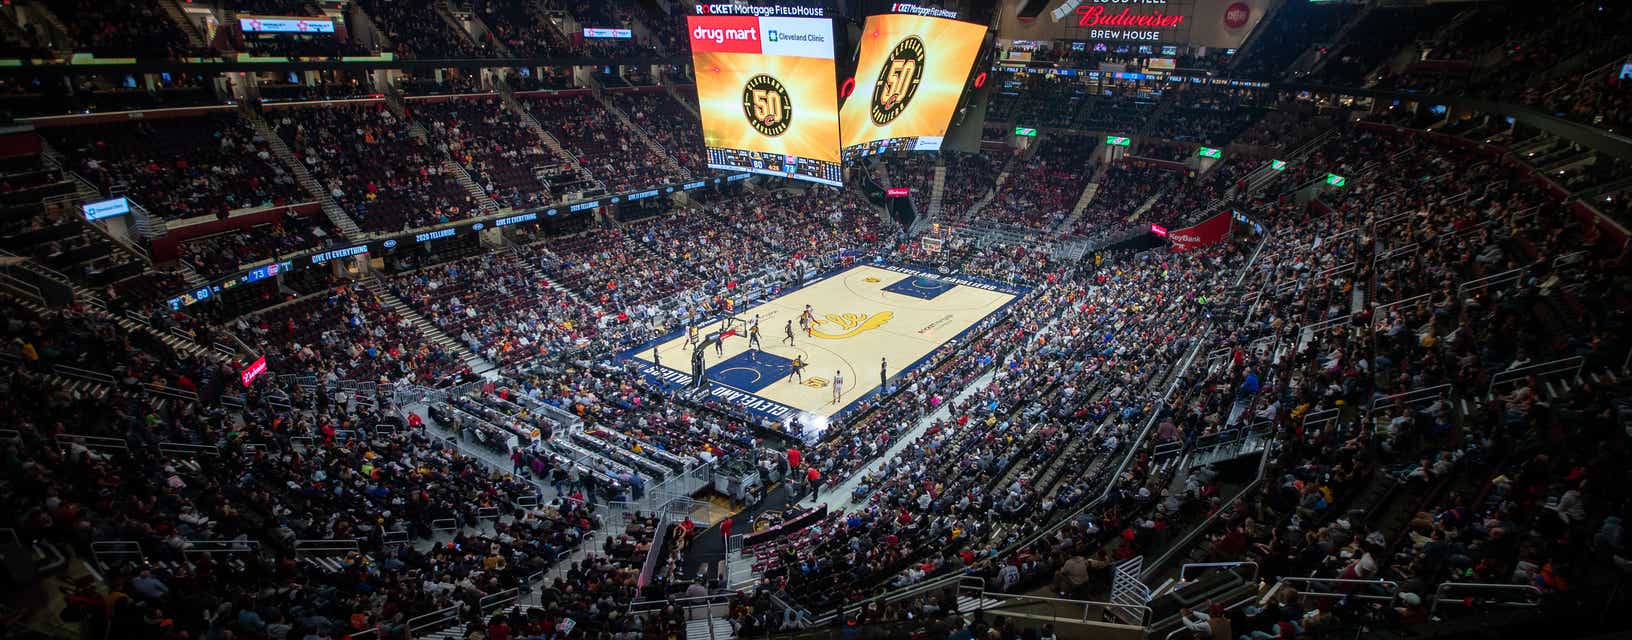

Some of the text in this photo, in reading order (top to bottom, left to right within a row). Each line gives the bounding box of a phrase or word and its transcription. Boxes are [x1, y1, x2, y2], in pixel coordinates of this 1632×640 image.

[696, 4, 733, 15] ROCKET
[734, 5, 774, 16] Mortgage
[1076, 5, 1184, 27] Budweiser
[693, 26, 757, 43] drug mart
[779, 33, 825, 43] Cleveland Clinic
[1091, 30, 1160, 41] BREW HOUSE
[747, 76, 785, 94] CLEVELAND
[881, 59, 916, 104] 50
[752, 89, 783, 122] 50
[752, 119, 787, 135] CAVALIERS
[753, 160, 763, 169] 80
[785, 164, 795, 173] 73
[416, 233, 429, 242] 2020
[1168, 233, 1201, 242] KeyBank
[311, 244, 368, 264] GIVE IT EVERYTHING
[253, 270, 264, 279] 73
[196, 289, 208, 300] 80
[712, 386, 789, 416] CLEVELAND
